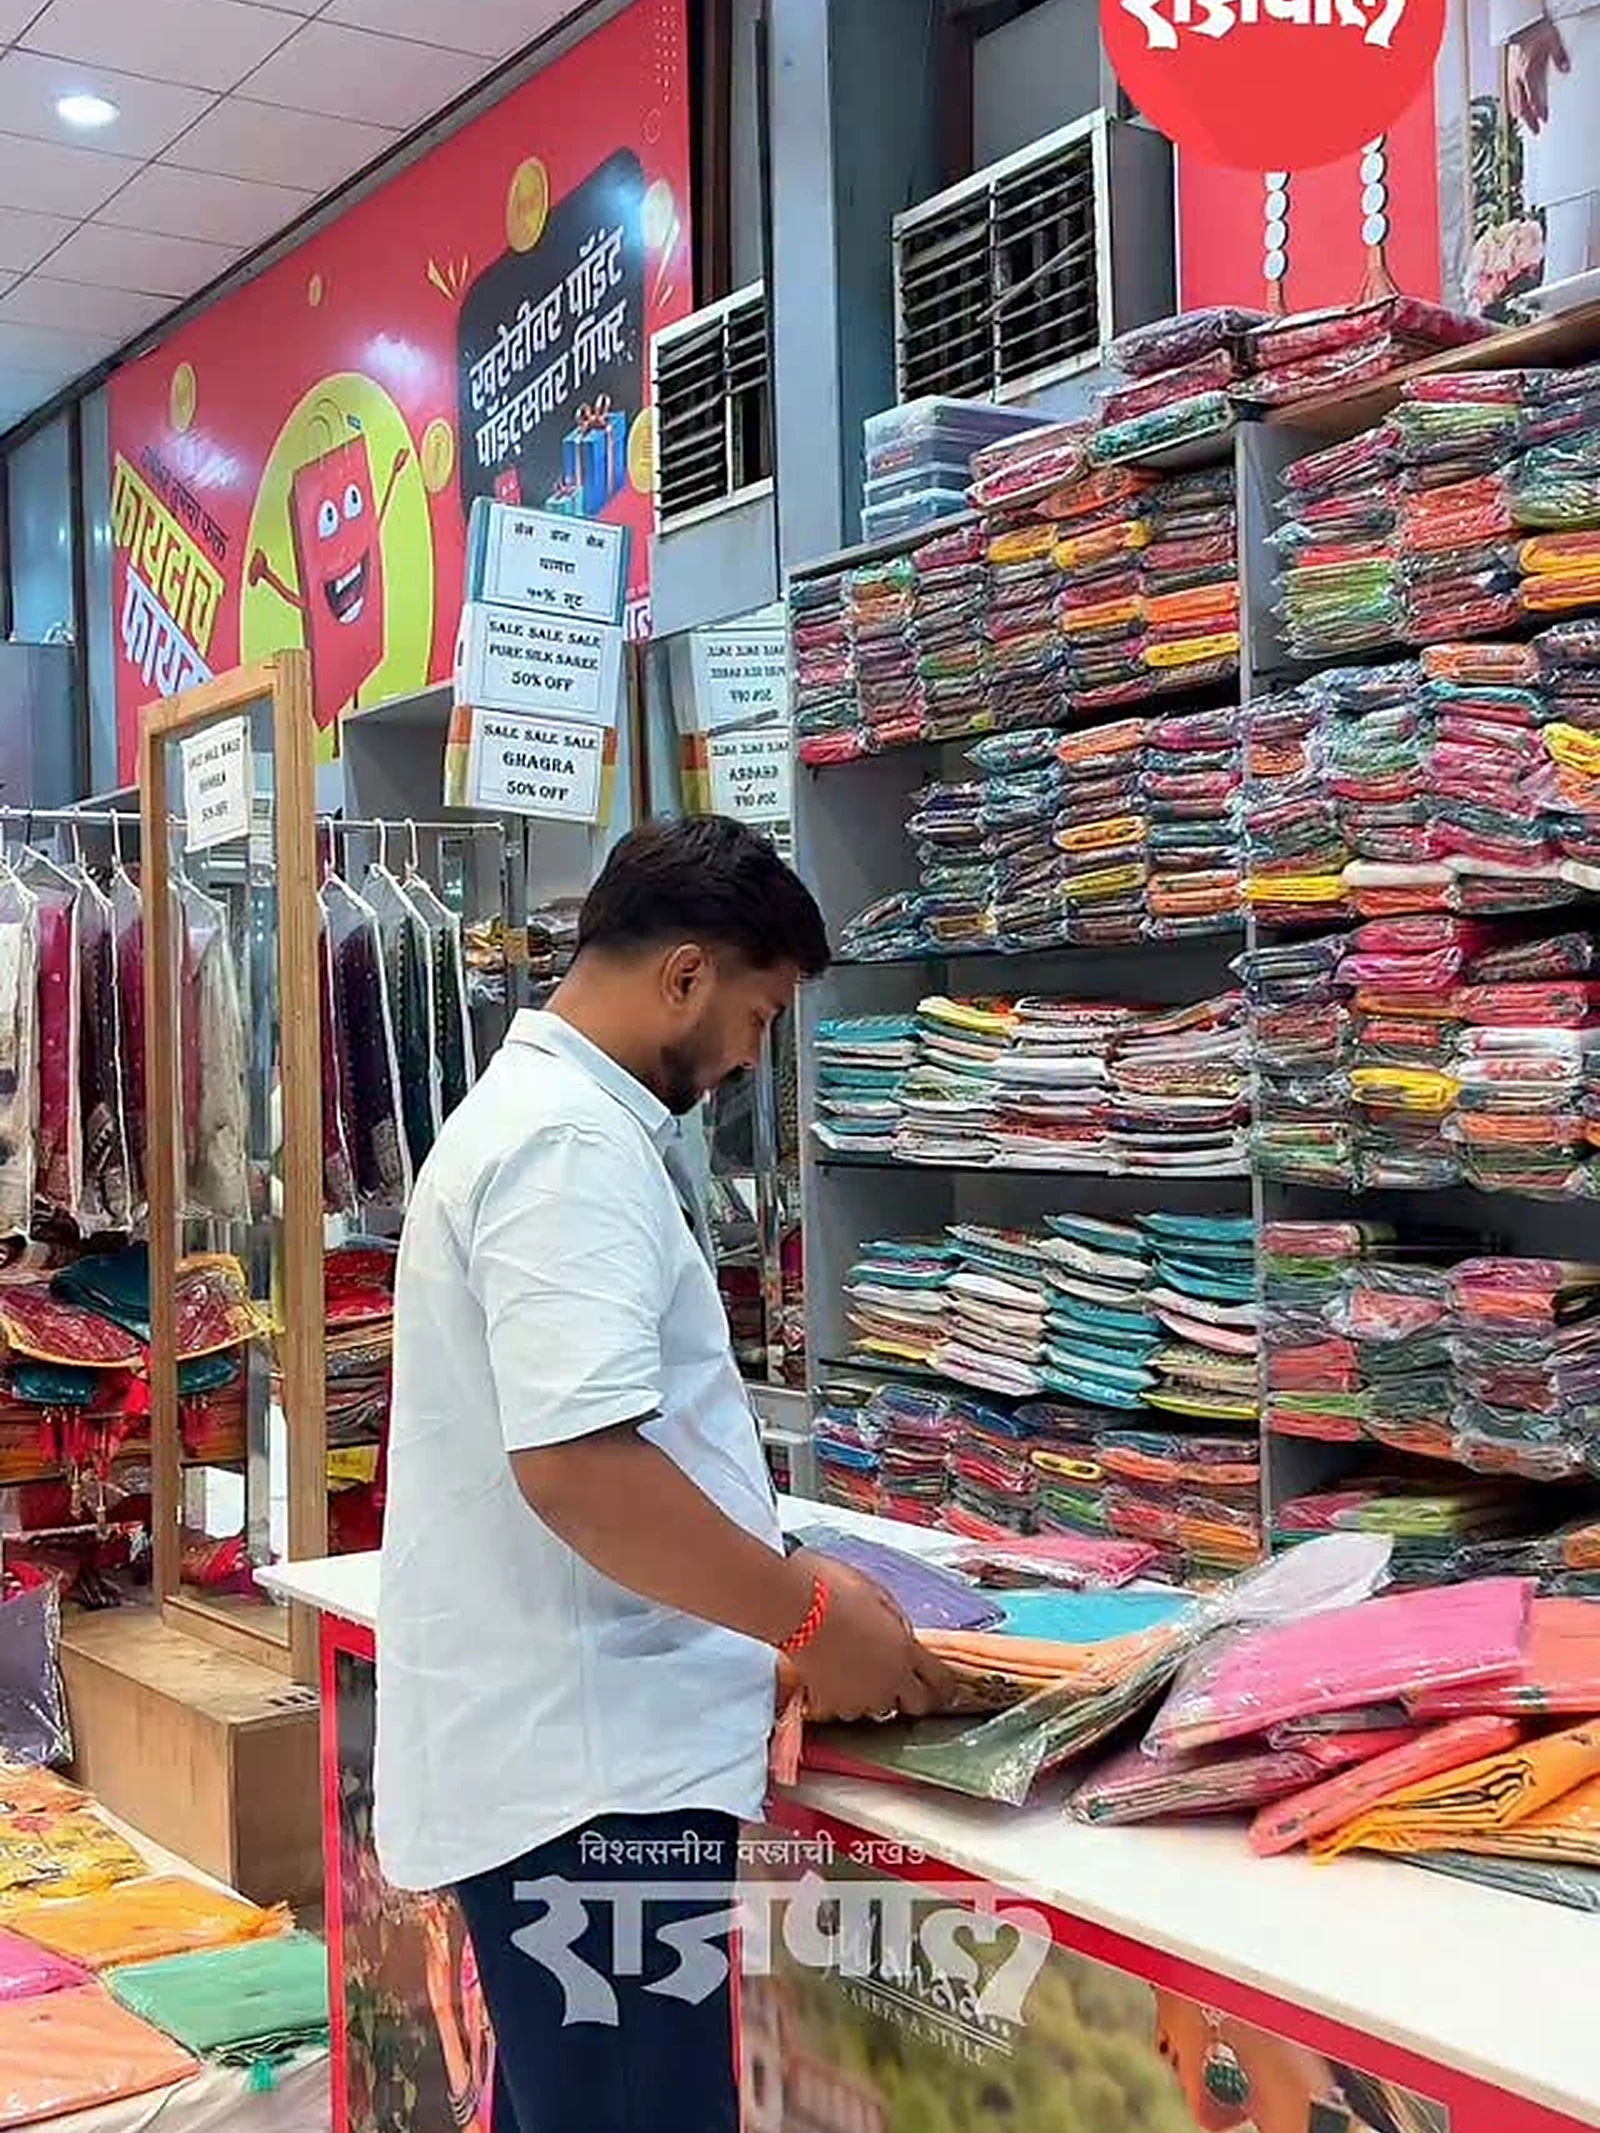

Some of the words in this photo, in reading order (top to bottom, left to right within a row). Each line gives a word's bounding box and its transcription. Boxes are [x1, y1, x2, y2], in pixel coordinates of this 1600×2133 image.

[469, 283, 564, 410] खरेदीवर
[572, 299, 627, 389] गिफ्ट
[112, 450, 226, 659] फायदाच
[122, 564, 214, 699] फायद
[489, 620, 523, 637] SALE
[528, 627, 563, 643] SALE
[568, 633, 601, 649] SALE
[489, 643, 523, 659] PURE
[525, 648, 553, 664] SILK
[555, 654, 599, 671] SAREE
[511, 670, 542, 688] 50%
[544, 675, 574, 692] OFF
[484, 723, 518, 739] SALE
[524, 730, 559, 745] SALE
[563, 735, 598, 750] SALE
[502, 750, 575, 775] GHAGRA
[507, 780, 536, 797] 50%
[539, 786, 569, 801] OFF
